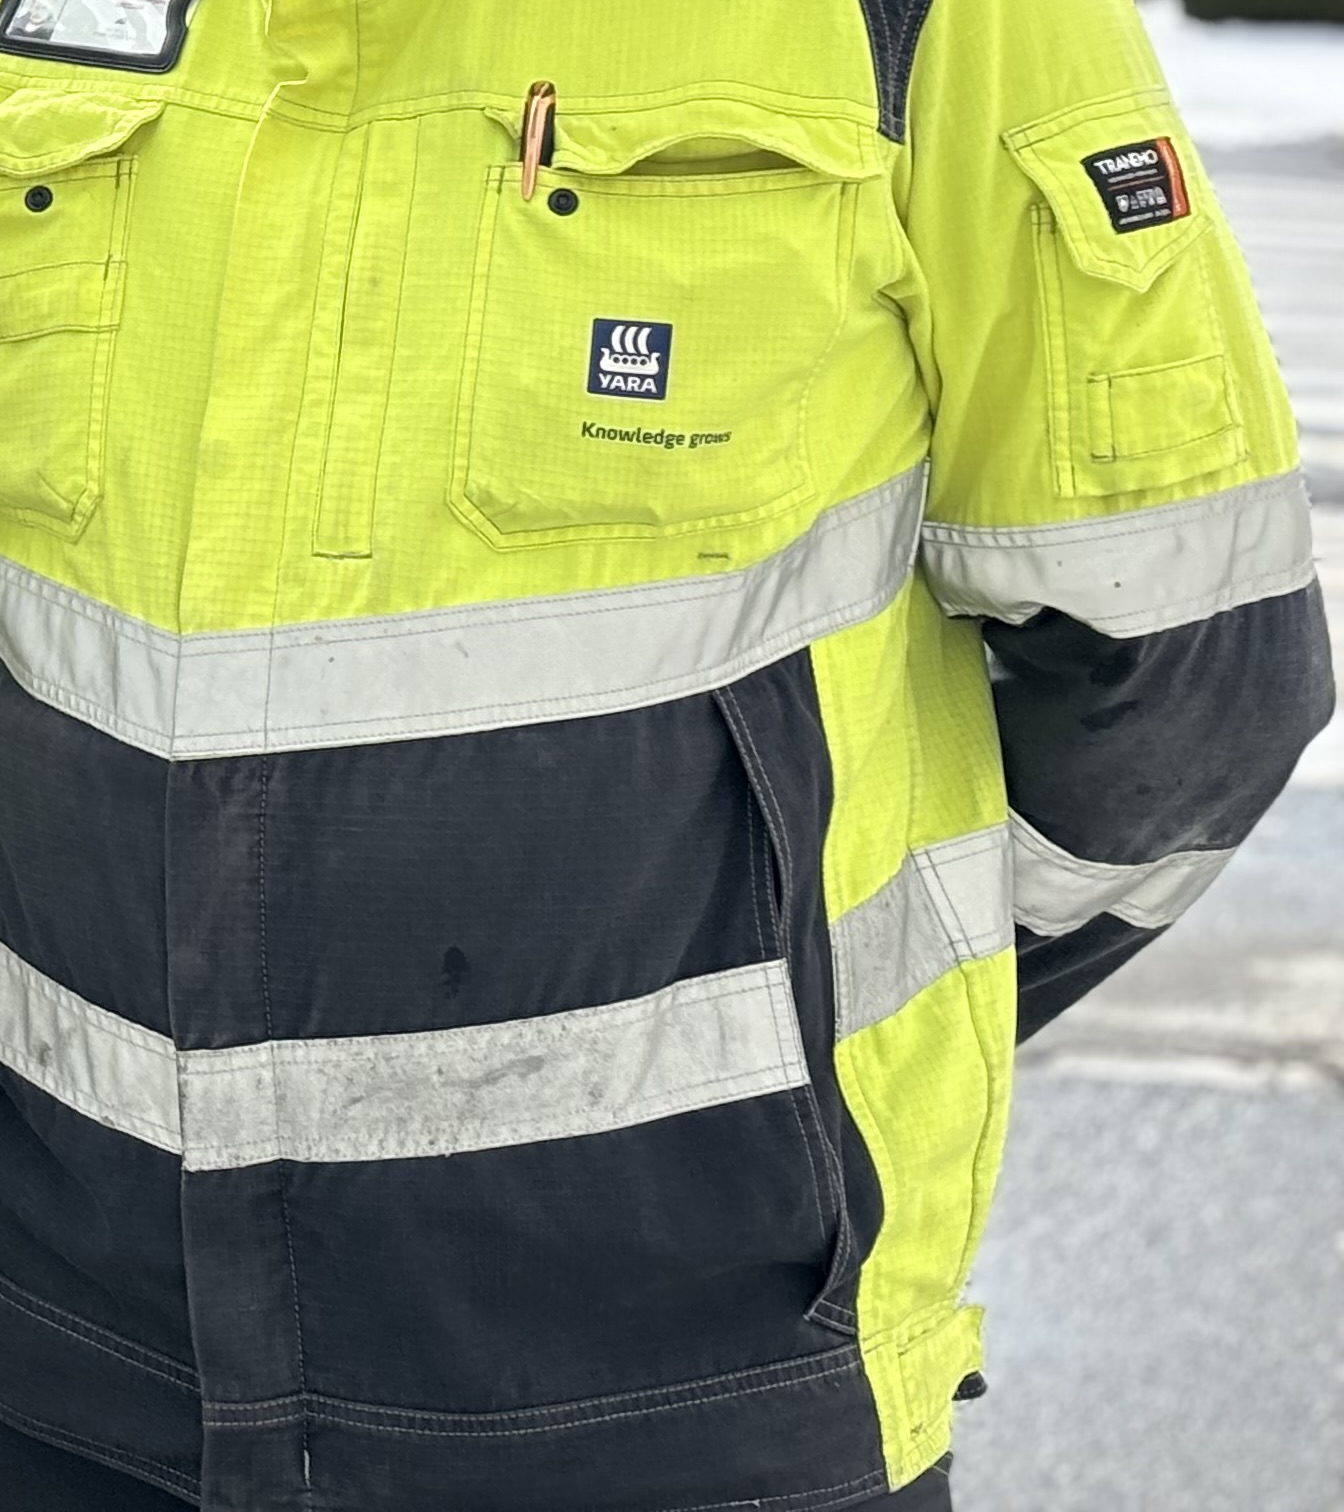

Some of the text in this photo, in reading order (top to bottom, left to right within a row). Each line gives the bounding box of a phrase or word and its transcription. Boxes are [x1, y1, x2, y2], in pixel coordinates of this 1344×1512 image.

[598, 372, 658, 394] YARA
[581, 421, 732, 450] Knowledge grows
